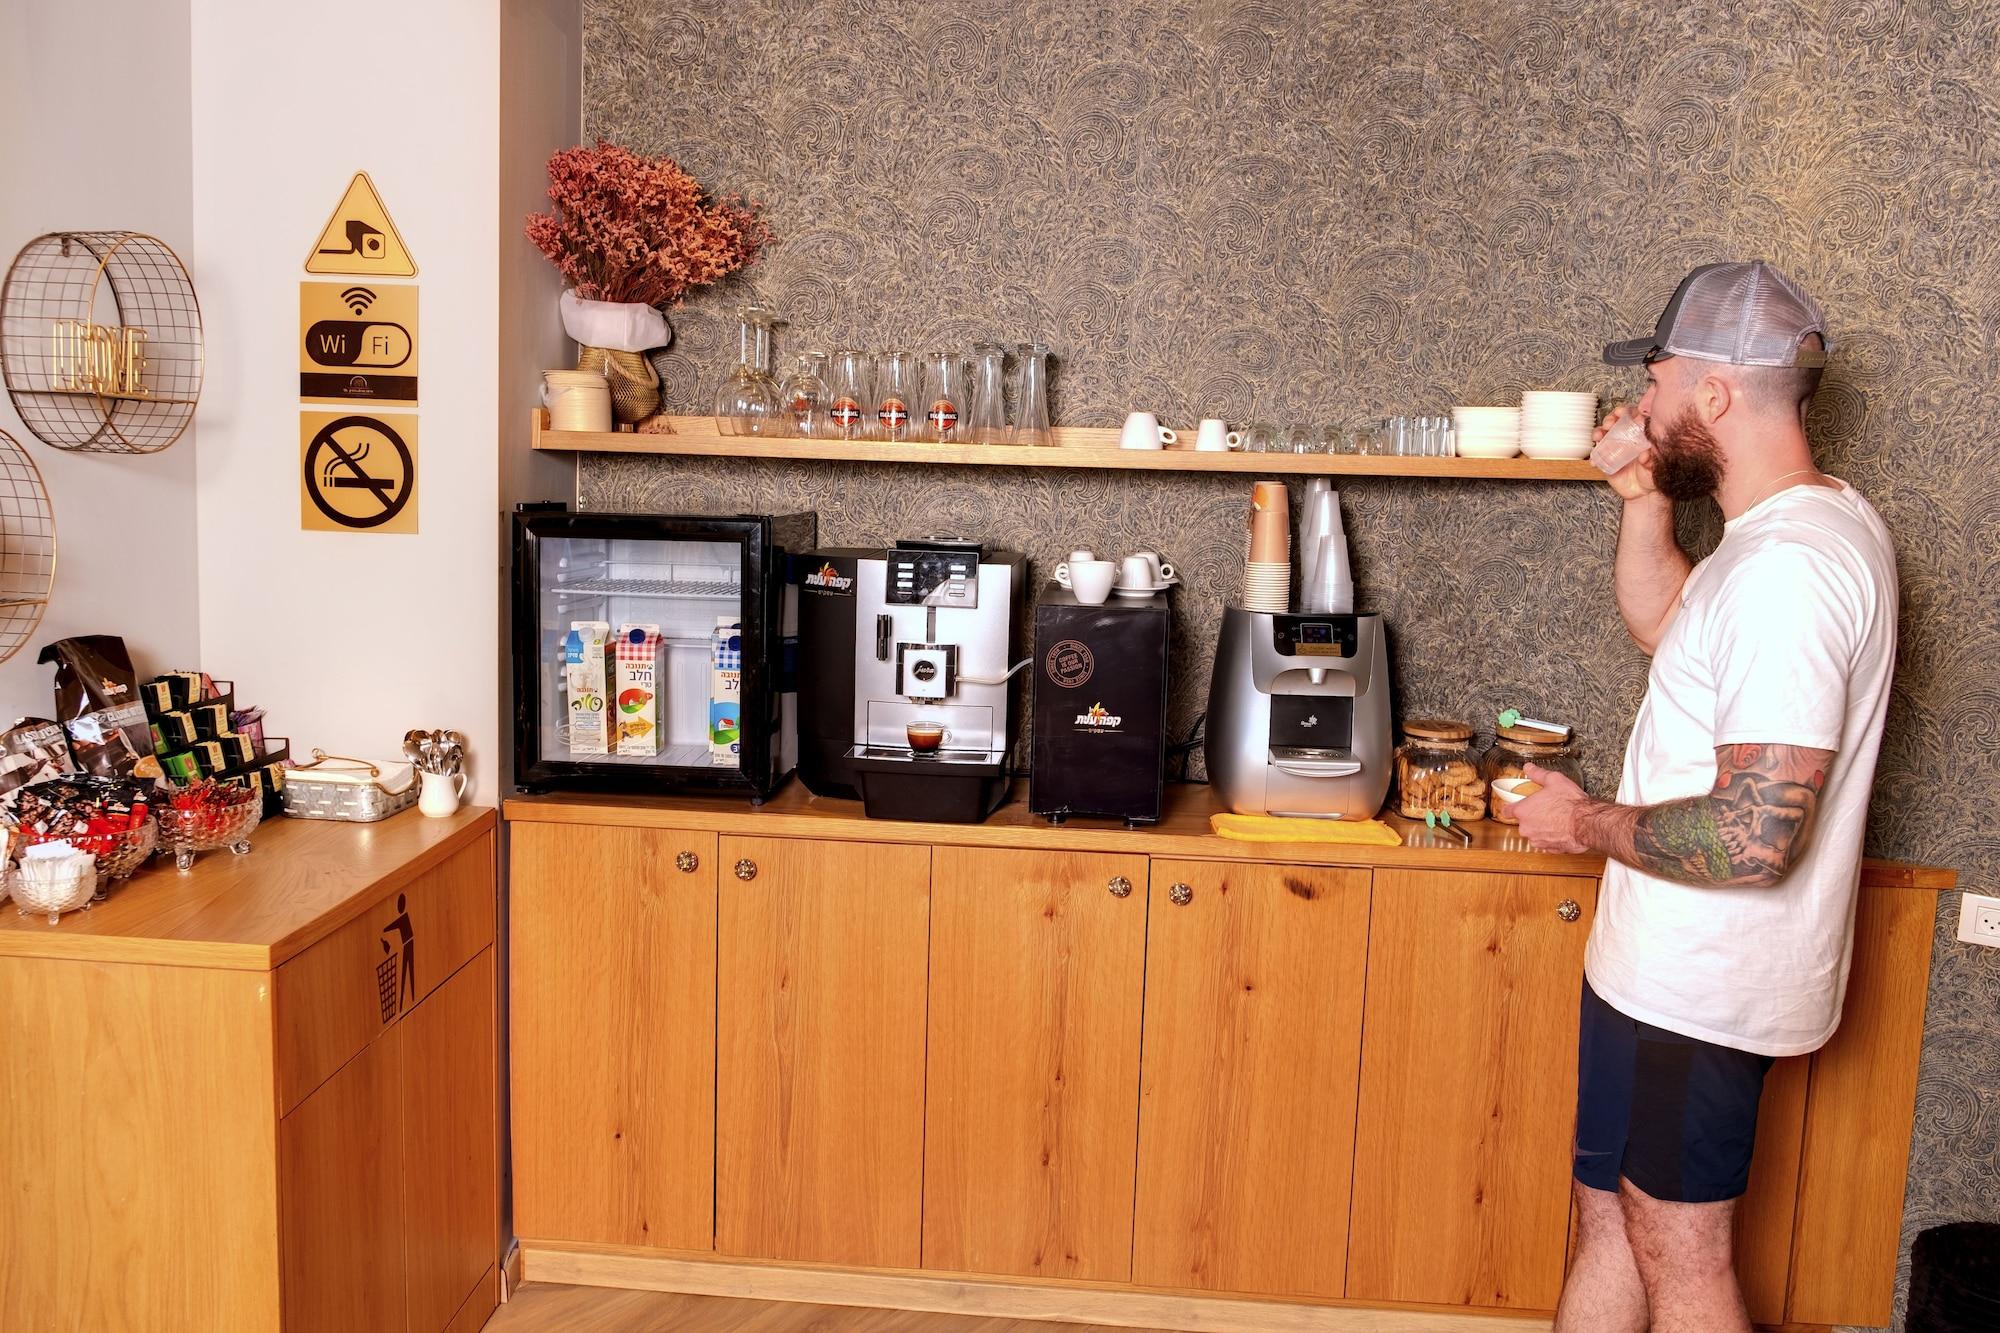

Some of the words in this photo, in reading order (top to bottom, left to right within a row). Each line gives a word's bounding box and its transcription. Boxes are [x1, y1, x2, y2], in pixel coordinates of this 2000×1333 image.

[320, 334, 346, 354] Wi
[373, 336, 389, 355] Fi
[805, 572, 828, 586] עלית
[829, 576, 853, 590] קפה
[1059, 653, 1078, 663] COFFEE
[1060, 663, 1083, 674] PASSION
[629, 670, 652, 681] חלב
[725, 678, 740, 690] לב
[1074, 712, 1098, 726] עלית
[1099, 716, 1121, 728] קפה
